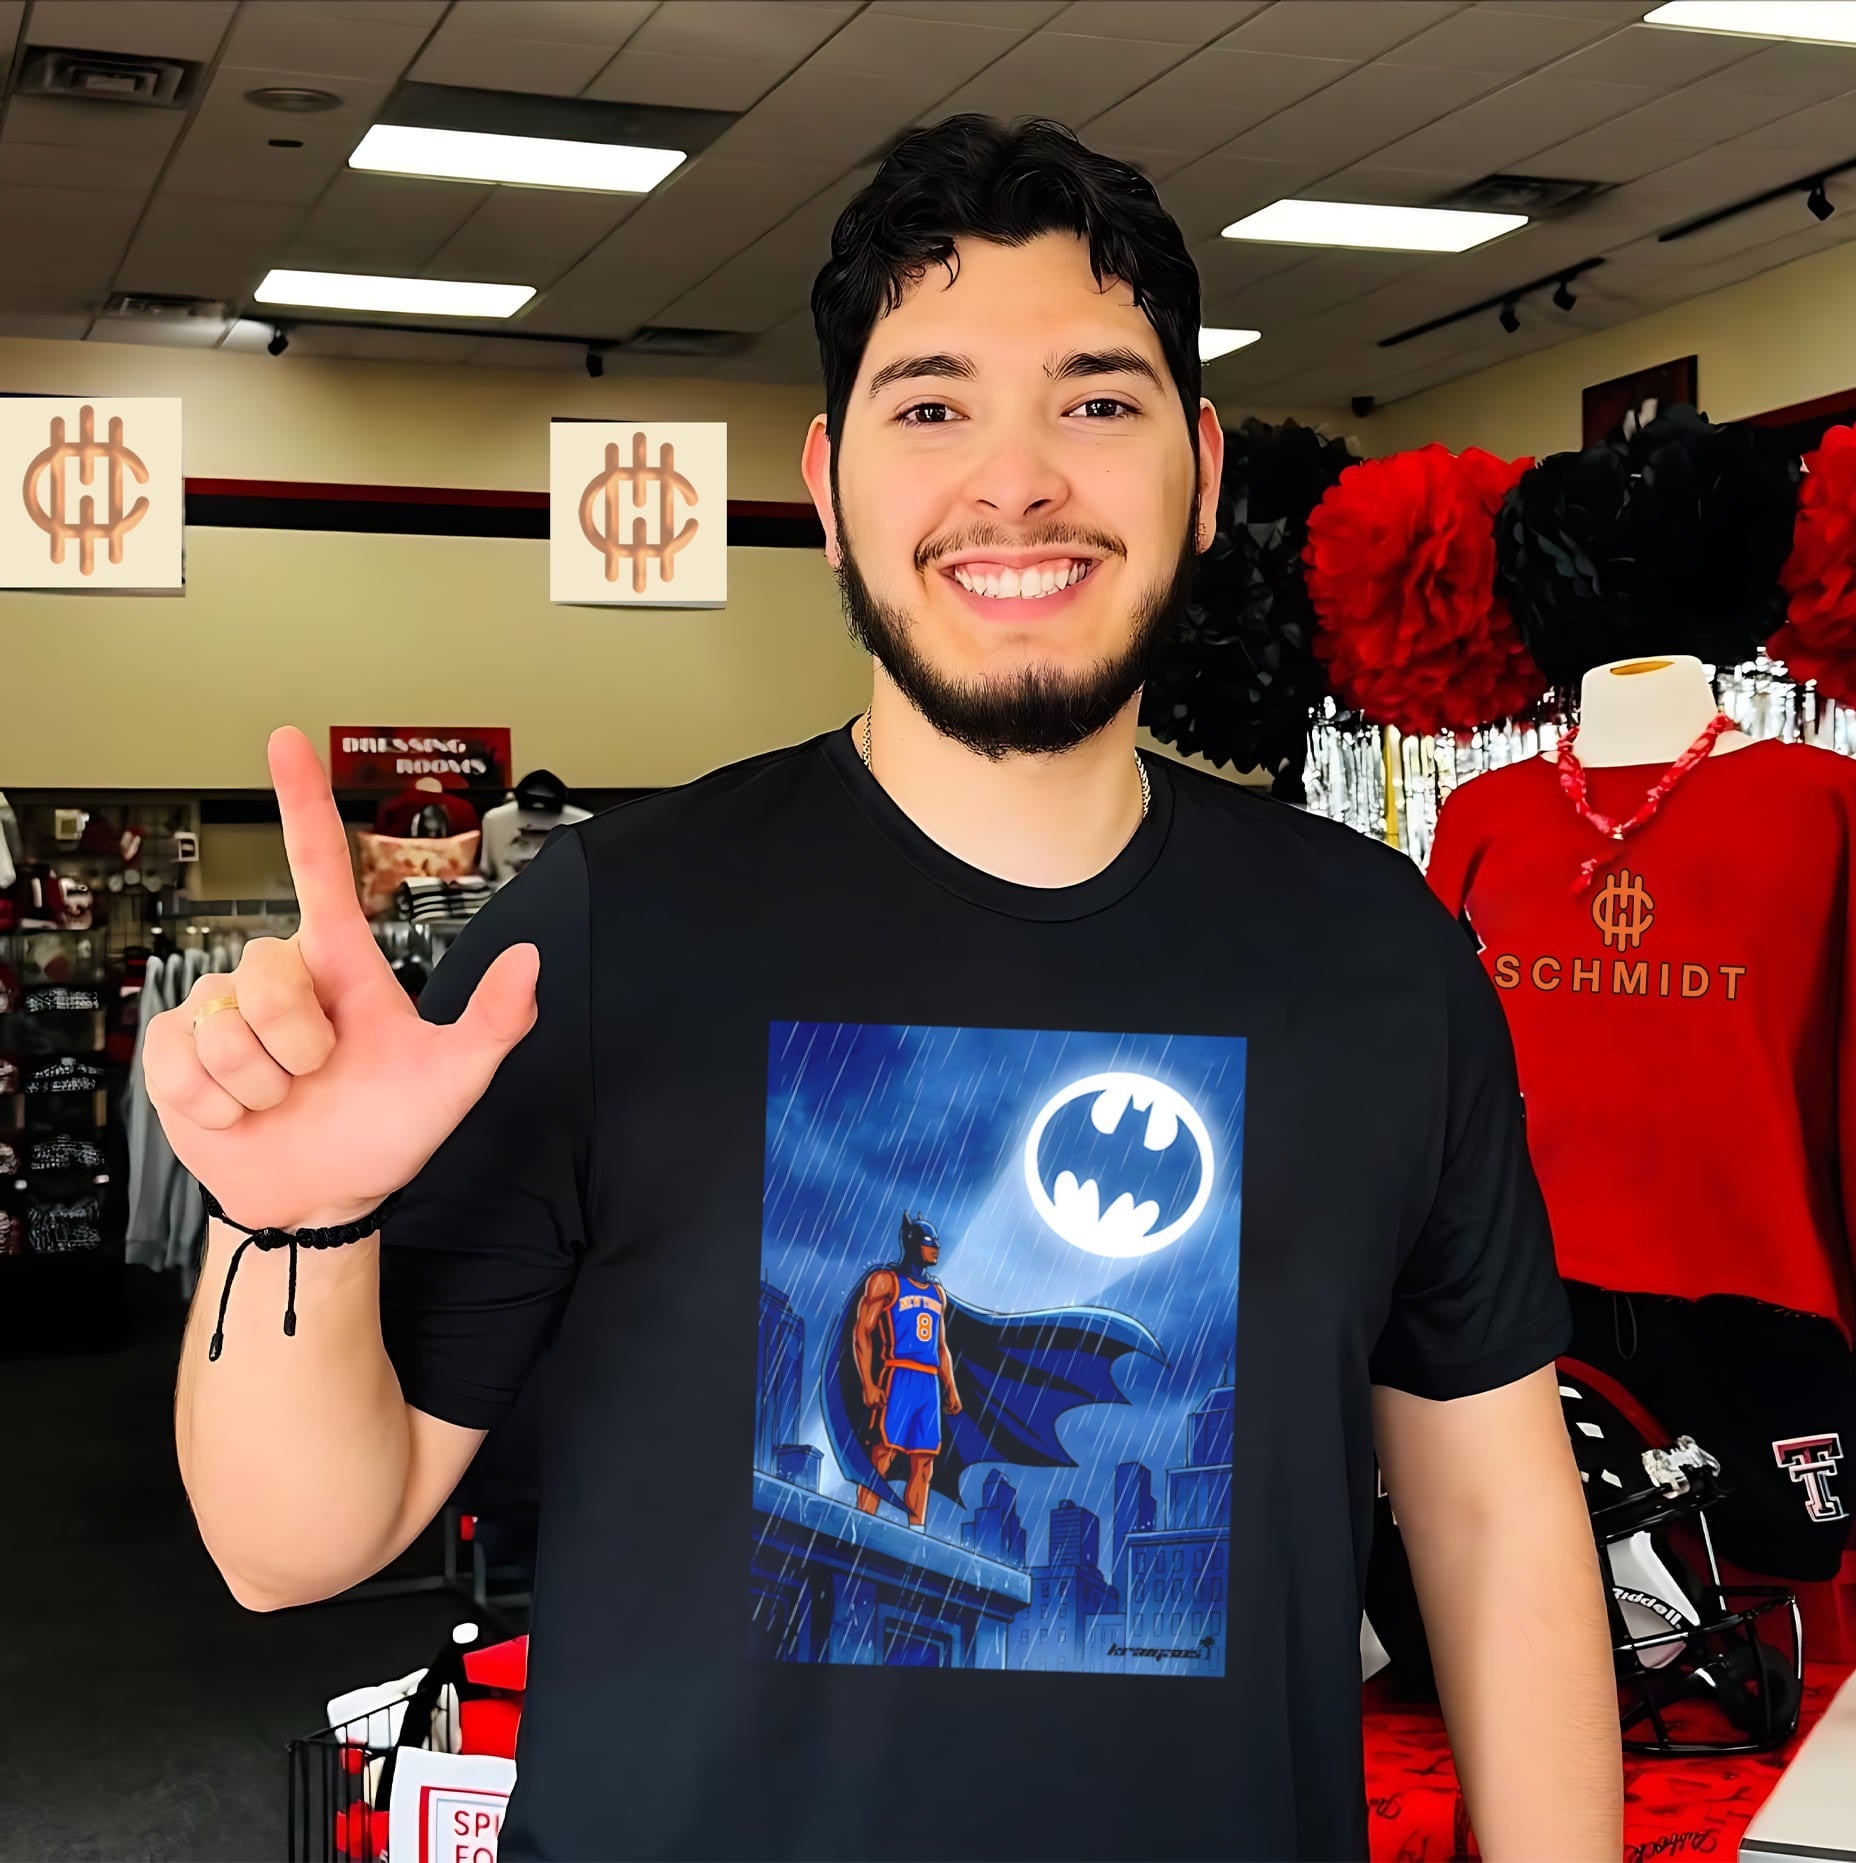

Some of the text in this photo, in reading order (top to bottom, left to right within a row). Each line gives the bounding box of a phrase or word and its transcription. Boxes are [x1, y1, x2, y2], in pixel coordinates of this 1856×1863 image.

[396, 758, 487, 774] ROOMS
[1494, 955, 1746, 1000] SCHMIDT
[916, 1312, 933, 1342] 8
